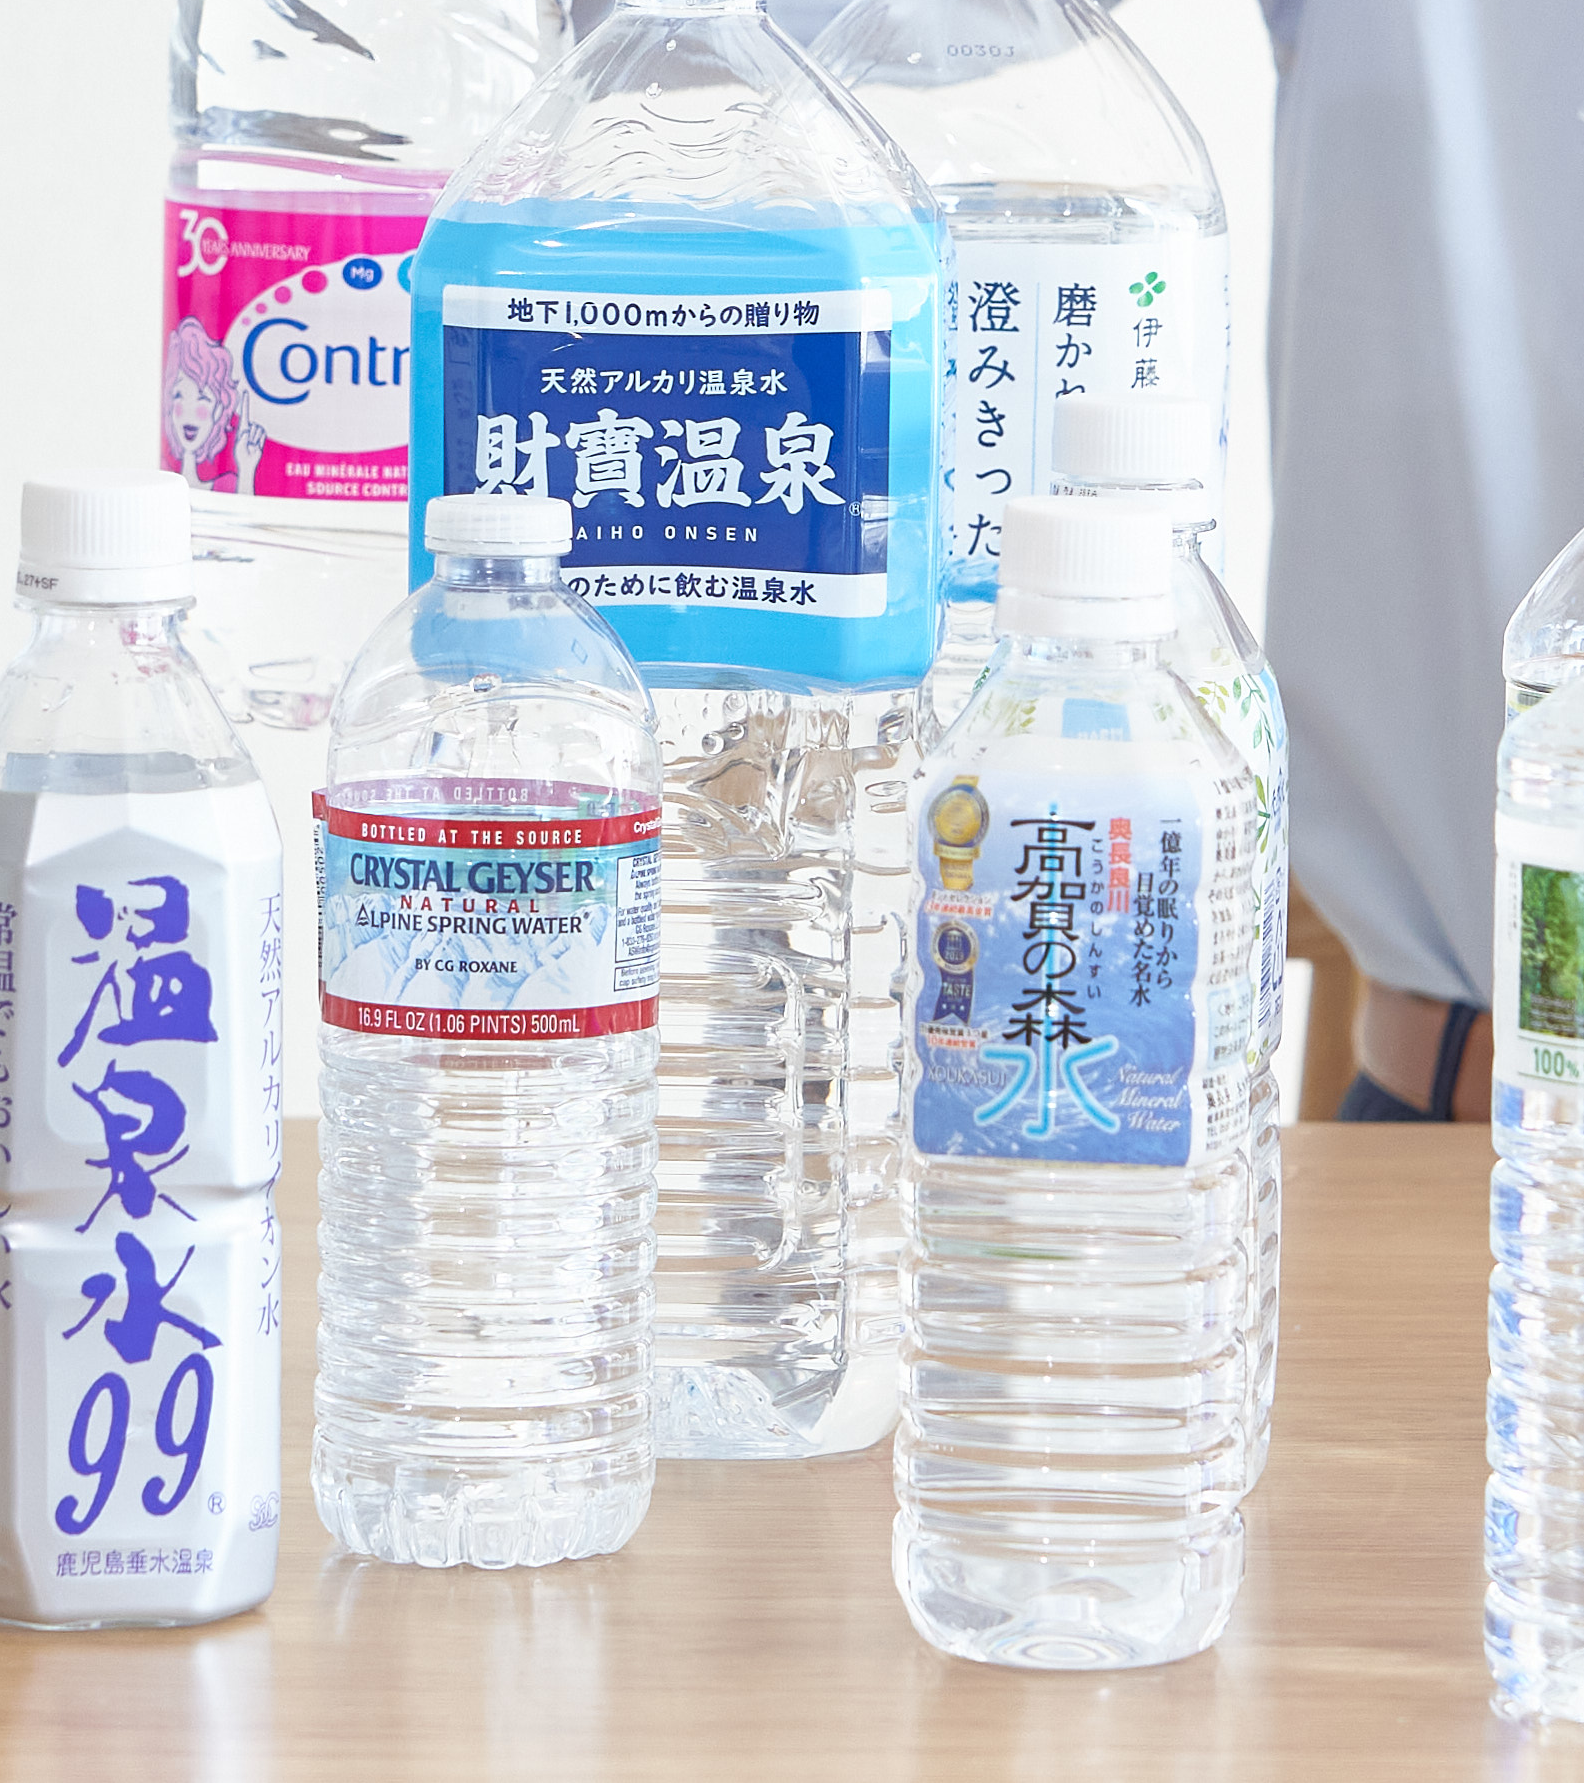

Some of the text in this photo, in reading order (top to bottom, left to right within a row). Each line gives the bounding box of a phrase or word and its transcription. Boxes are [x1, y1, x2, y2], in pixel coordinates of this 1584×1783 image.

[177, 208, 229, 278] 30
[231, 243, 312, 262] ANNIVERSARY
[350, 264, 375, 283] Mg
[507, 296, 821, 329] 地下1,000mからの贈り物
[1129, 316, 1166, 389] 伊藤
[539, 367, 789, 397] 天然アルカリ温泉水
[966, 280, 1022, 561] 澄みきった
[286, 461, 311, 477] EAU
[306, 480, 358, 496] SOURCE
[664, 525, 759, 542] ONSEN
[361, 822, 583, 846] BOTTLED AT THE SOURCE
[350, 853, 595, 895] CRYSTAL GEYSER
[1107, 816, 1133, 914] 奥長良川
[400, 896, 540, 914] NATURAL
[1087, 837, 1105, 1000] こうかのしんすい
[1156, 817, 1184, 991] 一億年の眠りから
[356, 904, 583, 935] ALPINE SPRING WATER
[1130, 871, 1156, 1008] 目覚めた名水
[415, 958, 518, 973] BY CG ROXANE
[942, 981, 972, 998] TASTE
[359, 1006, 581, 1035] 16.9 FL OZ (1.06 PINTS) 500mL
[257, 892, 284, 1337] 天然アルカリイオン水
[1126, 1110, 1181, 1132] Water
[55, 1550, 216, 1578] 鹿児島垂水温泉
